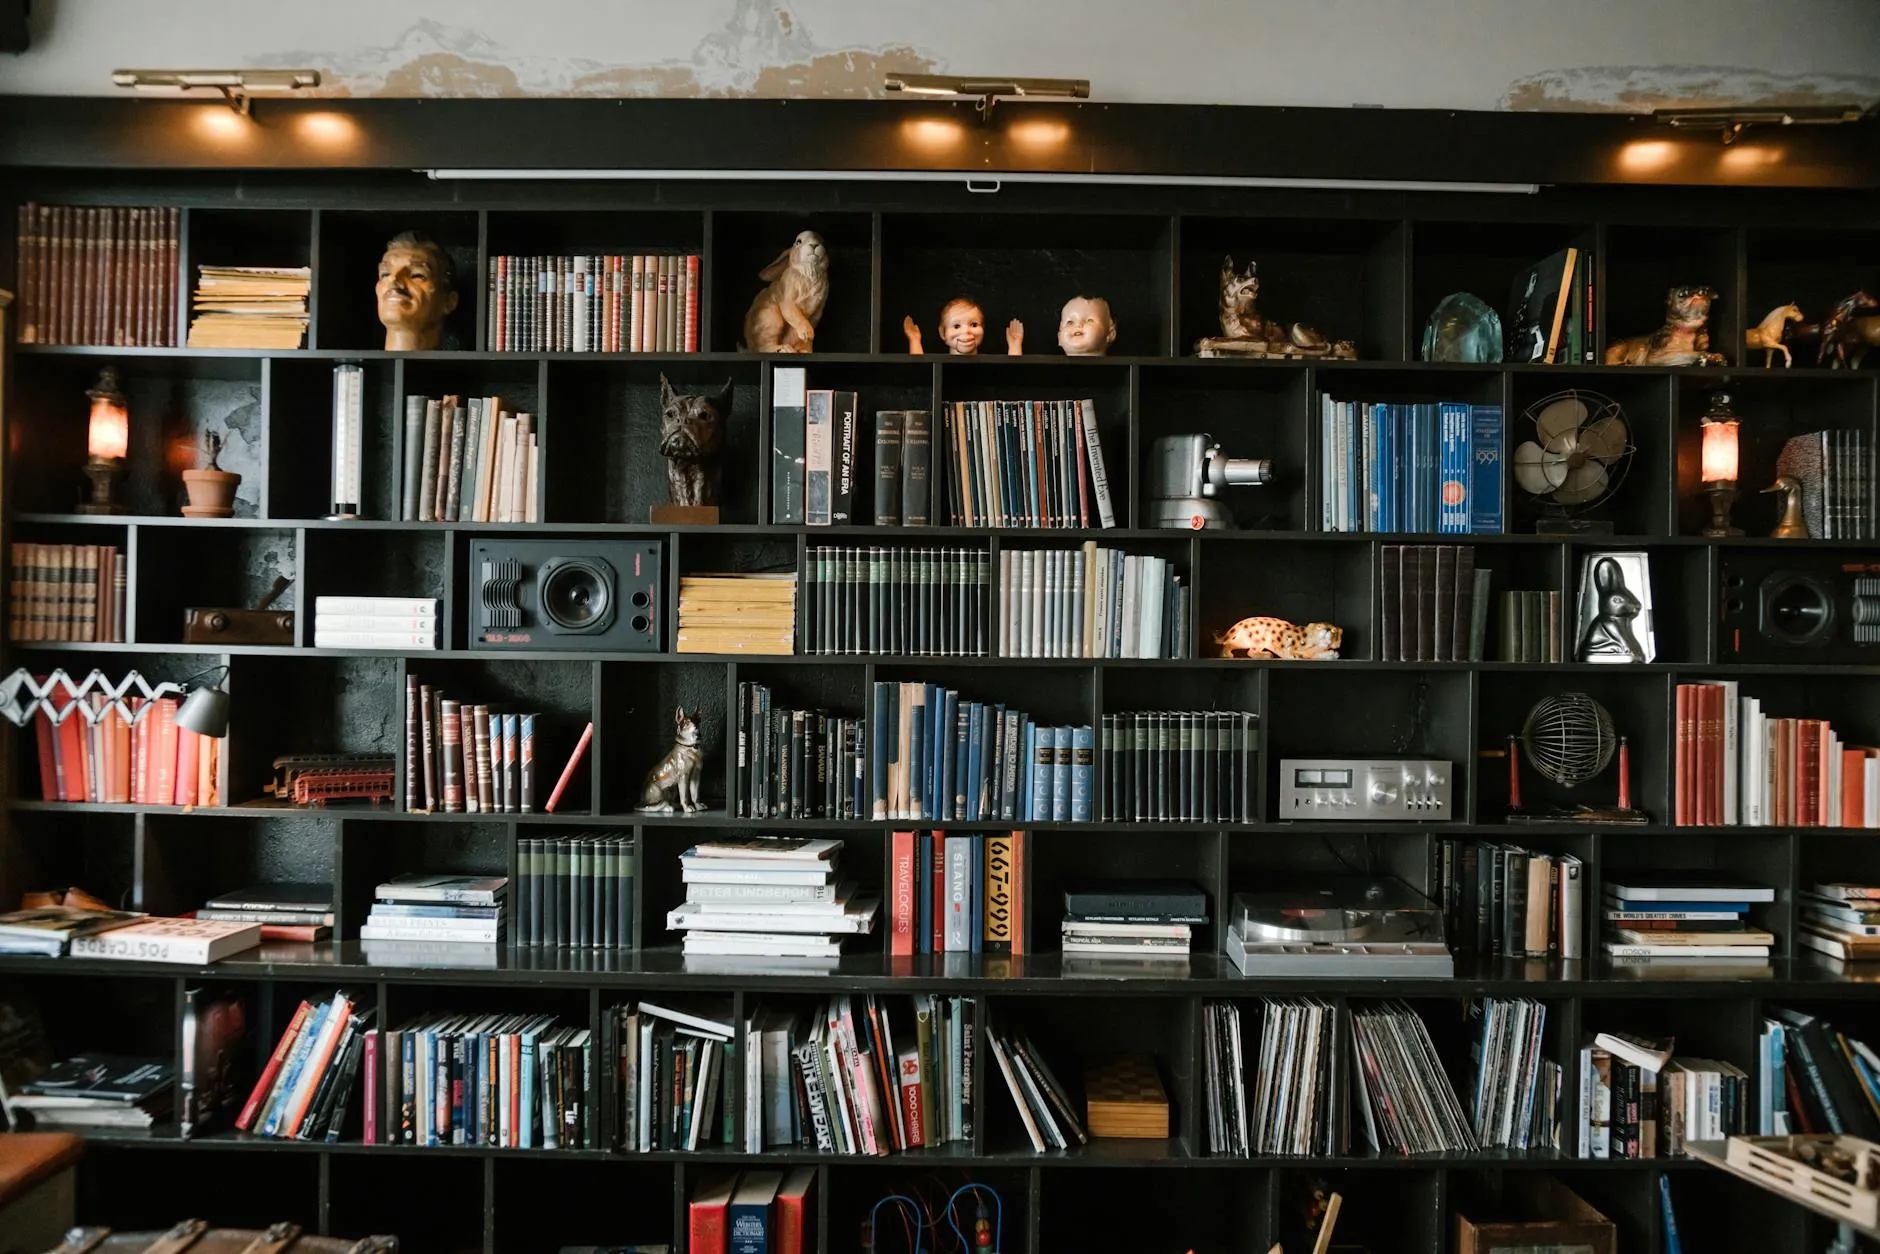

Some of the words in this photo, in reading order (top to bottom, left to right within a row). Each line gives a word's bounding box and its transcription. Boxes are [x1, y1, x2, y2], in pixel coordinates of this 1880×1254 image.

[842, 411, 852, 452] PORTRAIT
[1086, 424, 1099, 443] The
[841, 452, 850, 465] OF
[1090, 444, 1109, 483] Invented
[841, 465, 849, 477] AN
[840, 477, 849, 495] ERA
[1097, 484, 1110, 501] Eve
[738, 730, 746, 746] JEAN
[1009, 754, 1017, 764] TO
[1006, 764, 1016, 793] AMERICA
[953, 852, 963, 902] SLANG
[989, 841, 1010, 937] 667-999
[690, 886, 732, 898] PETER
[735, 887, 810, 898] LINDBERGH
[898, 855, 910, 933] TRAVELOGUES
[78, 938, 170, 959] POSTCARDS
[963, 1023, 973, 1049] Saint
[962, 1050, 972, 1105] Petersburg
[908, 1086, 918, 1110] 1000
[909, 1110, 921, 1143] CHAIRS
